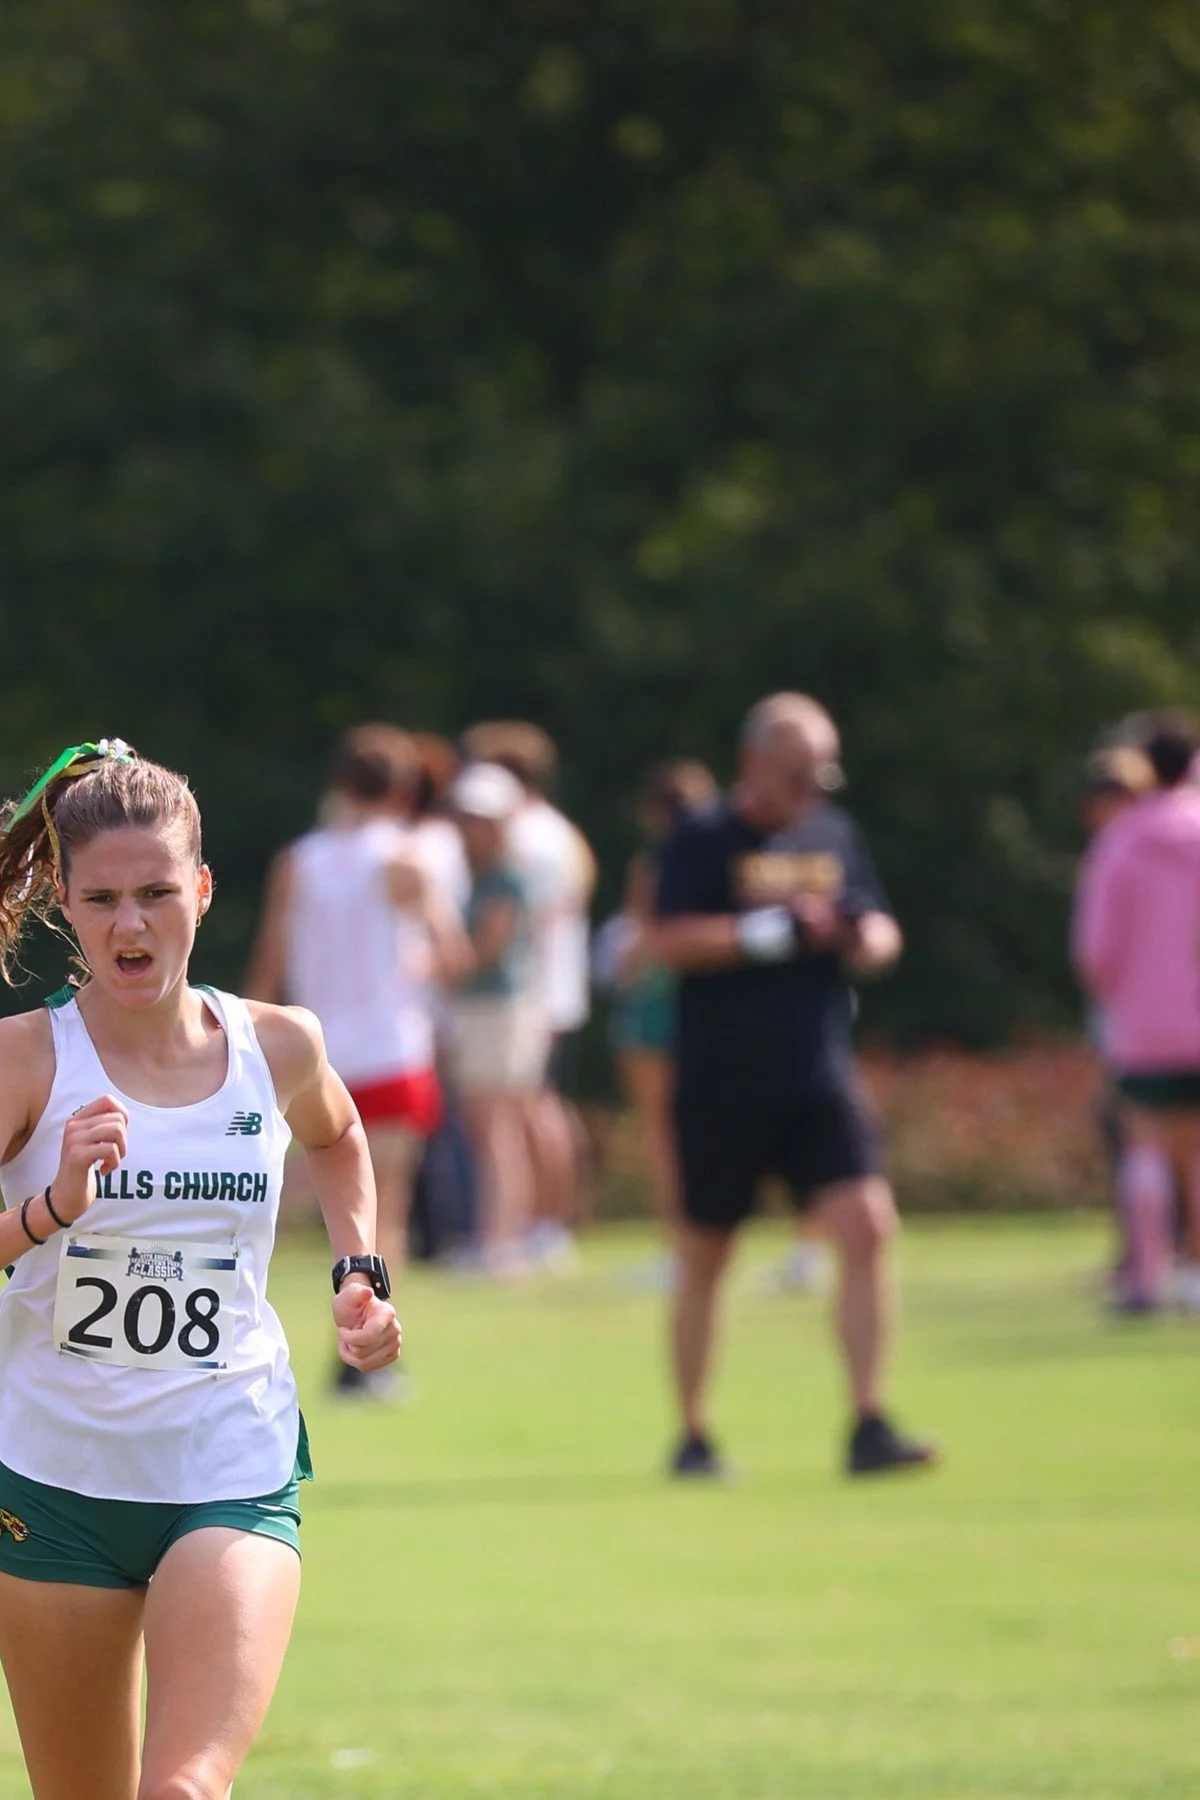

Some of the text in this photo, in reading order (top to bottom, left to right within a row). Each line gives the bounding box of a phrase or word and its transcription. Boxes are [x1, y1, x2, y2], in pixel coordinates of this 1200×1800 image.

[94, 1170, 268, 1203] LLS CHURCH
[133, 1263, 178, 1277] CLASSIC
[68, 1276, 220, 1358] 208
